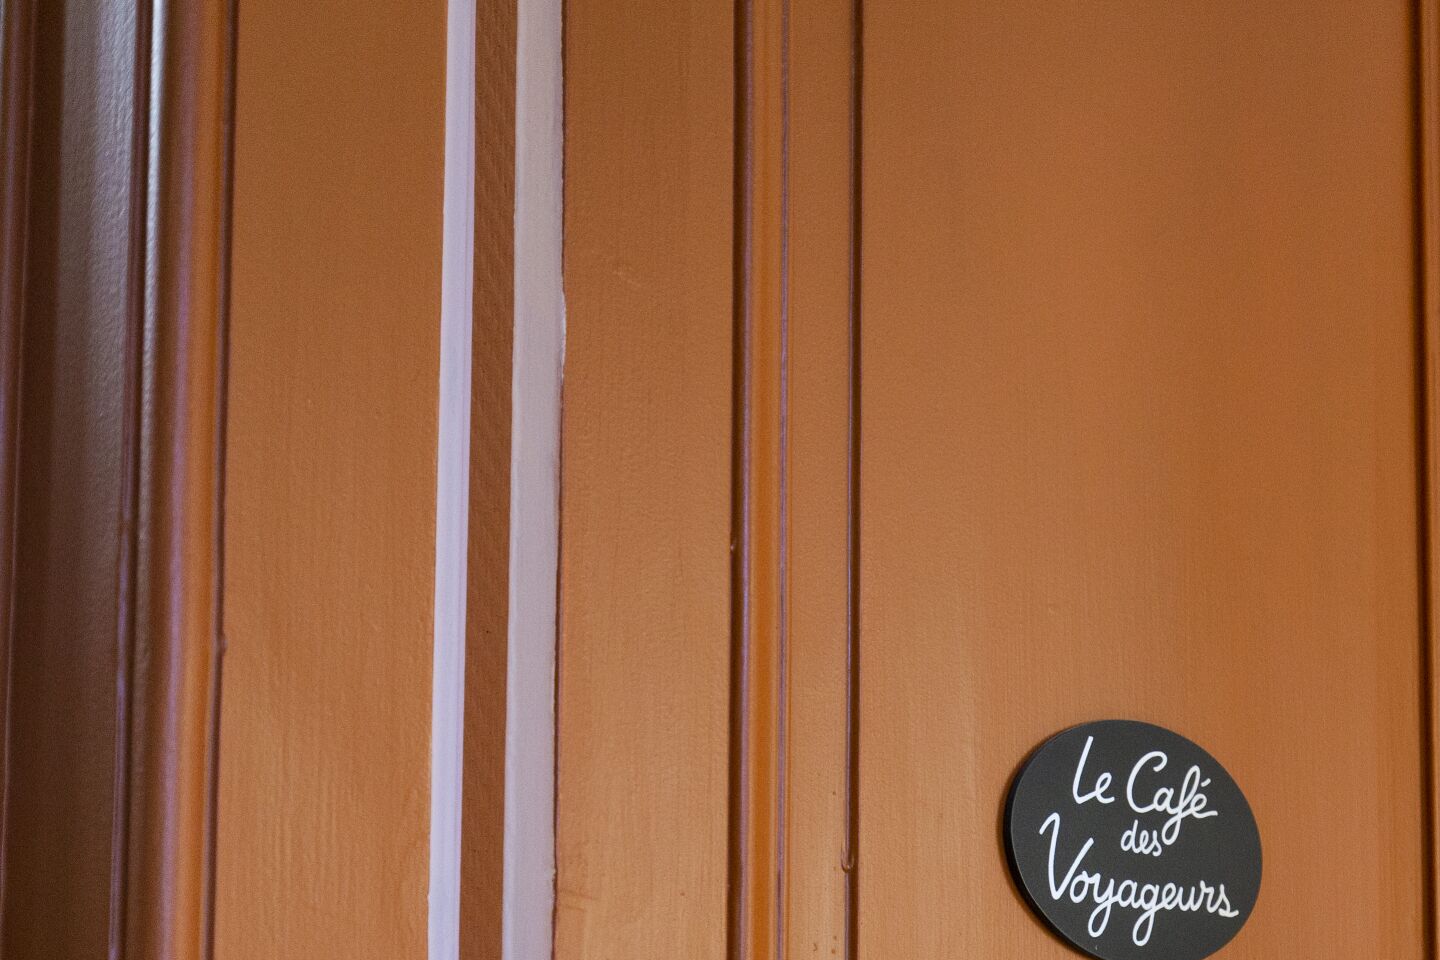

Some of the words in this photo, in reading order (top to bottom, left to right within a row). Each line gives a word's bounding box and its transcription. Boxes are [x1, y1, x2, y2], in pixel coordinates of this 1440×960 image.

[1072, 735, 1115, 804] Le
[1126, 750, 1218, 845] Café
[1120, 819, 1162, 856] des
[1039, 812, 1239, 946] Voyageurs
